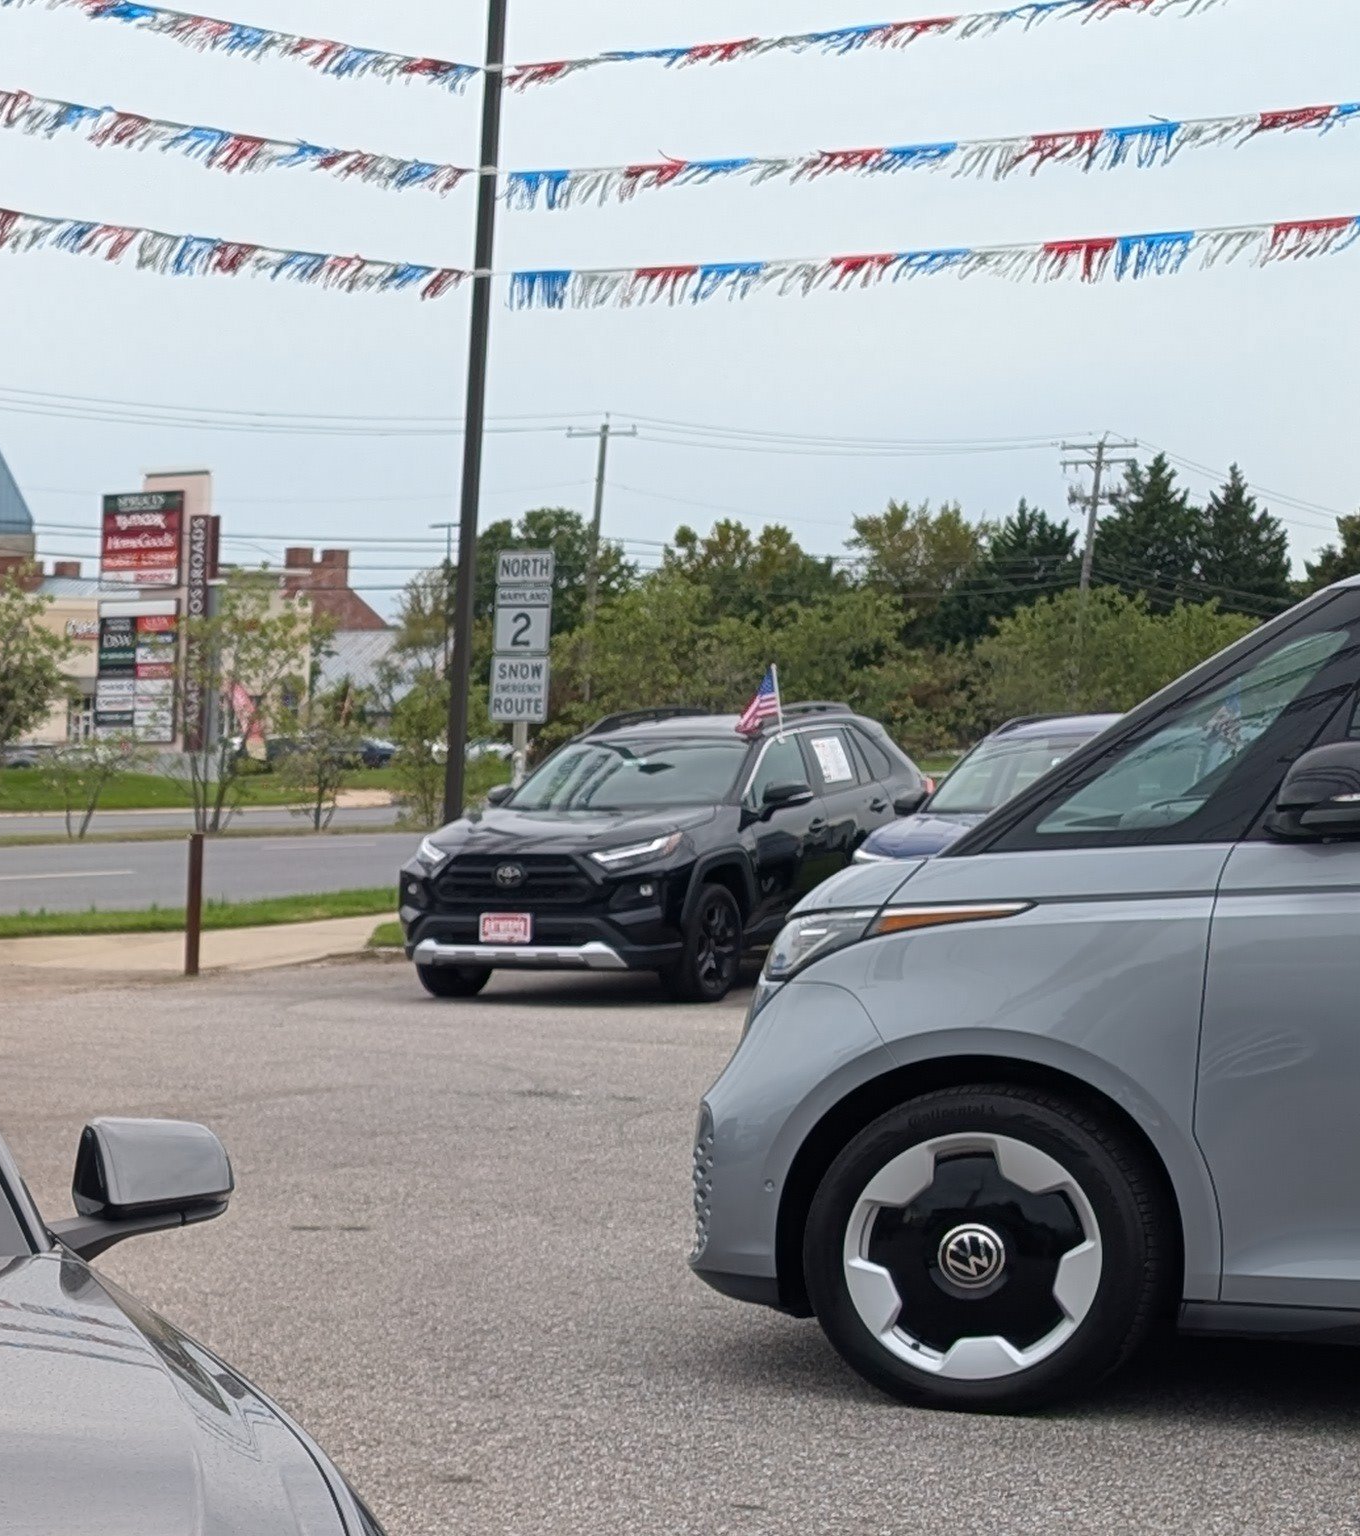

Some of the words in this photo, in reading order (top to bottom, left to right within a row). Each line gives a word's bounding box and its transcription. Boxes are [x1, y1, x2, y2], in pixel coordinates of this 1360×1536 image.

[500, 558, 550, 578] NORTH
[499, 591, 549, 602] MARYLAND
[511, 612, 532, 647] 2
[497, 662, 543, 680] SNOW
[495, 683, 542, 695] EMERGENCY
[492, 697, 543, 715] ROUTE
